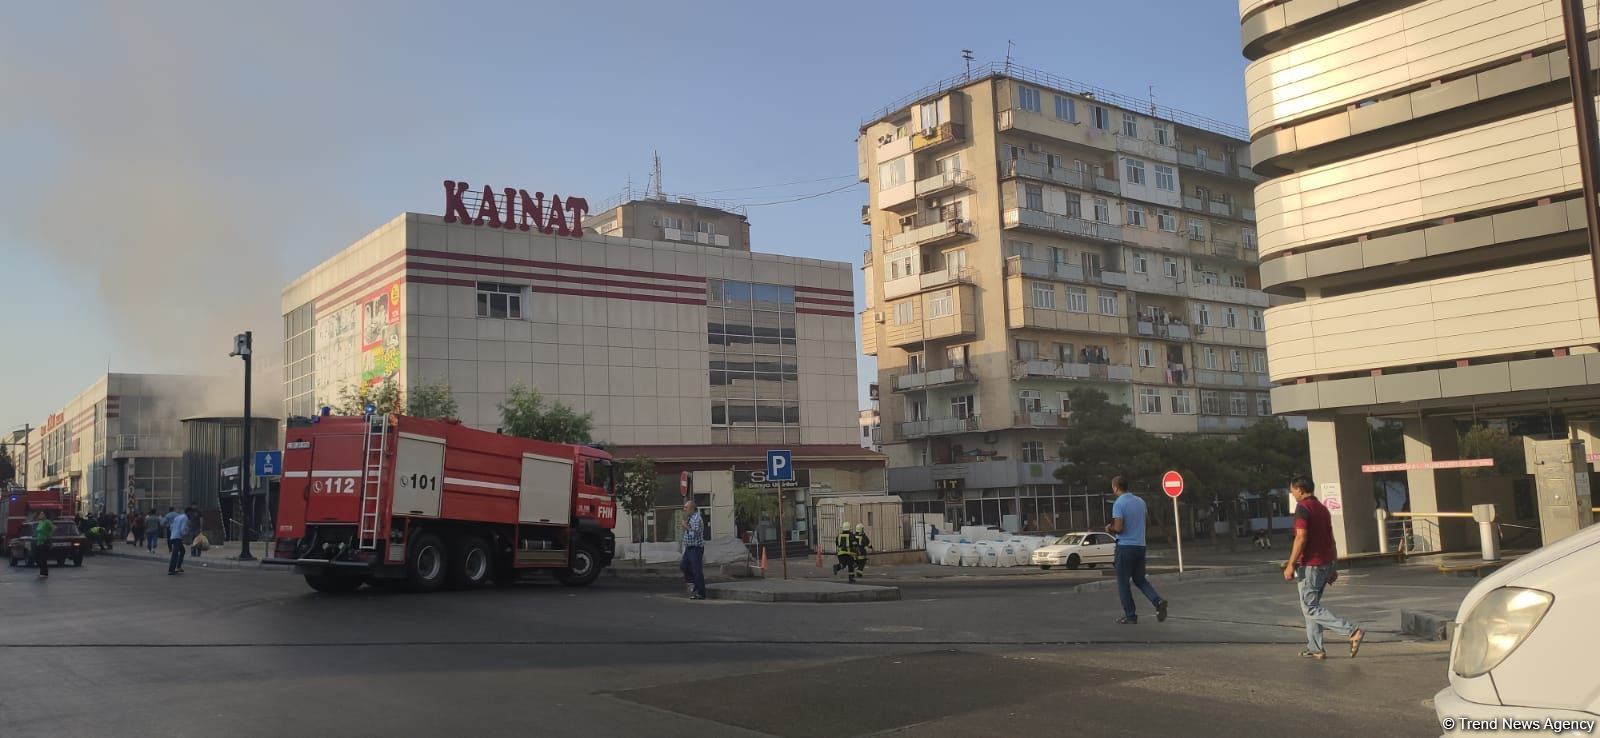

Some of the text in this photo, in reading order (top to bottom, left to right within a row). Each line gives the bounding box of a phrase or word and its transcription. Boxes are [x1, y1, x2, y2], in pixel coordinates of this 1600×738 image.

[444, 180, 589, 238] KAINAT
[772, 455, 786, 477] P
[324, 477, 355, 494] 112
[410, 473, 436, 491] 101
[597, 505, 613, 519] FHN
